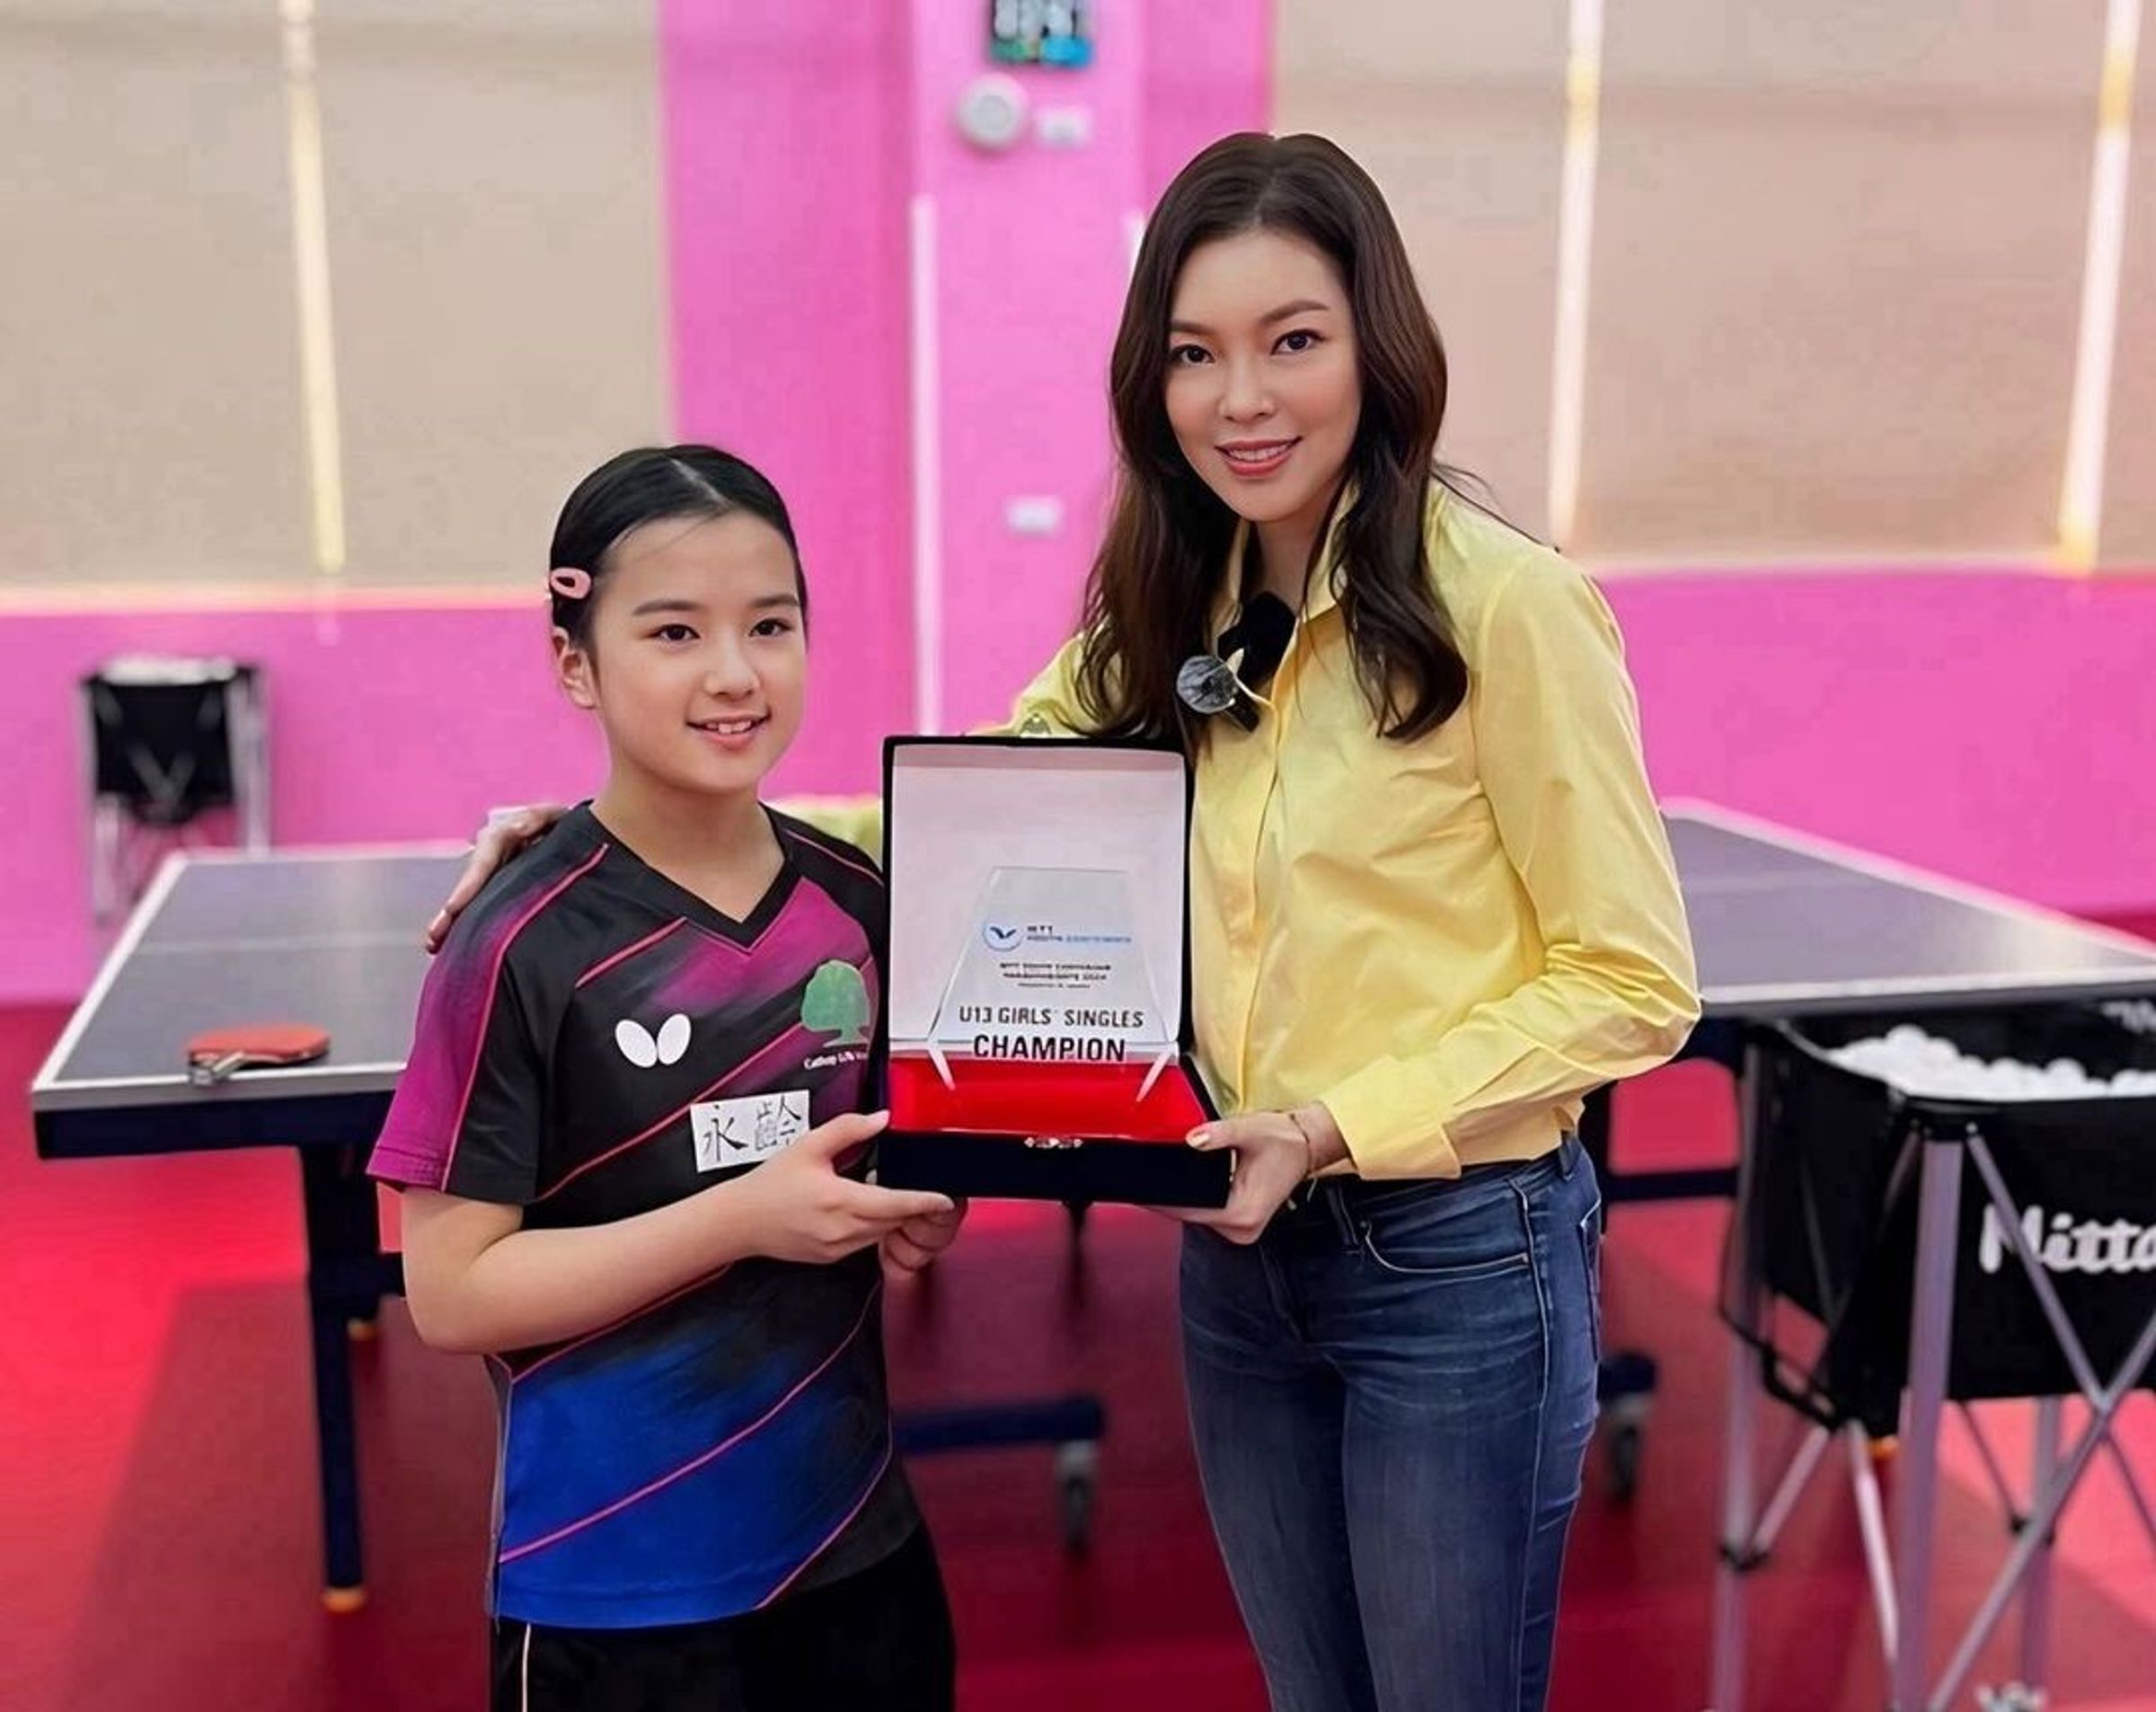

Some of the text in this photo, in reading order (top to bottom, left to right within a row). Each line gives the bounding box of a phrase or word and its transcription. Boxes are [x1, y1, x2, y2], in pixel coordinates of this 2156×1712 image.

[959, 1006, 992, 1022] U13
[1065, 1009, 1144, 1028] SINGLES
[974, 1035, 1126, 1062] CHAMPION
